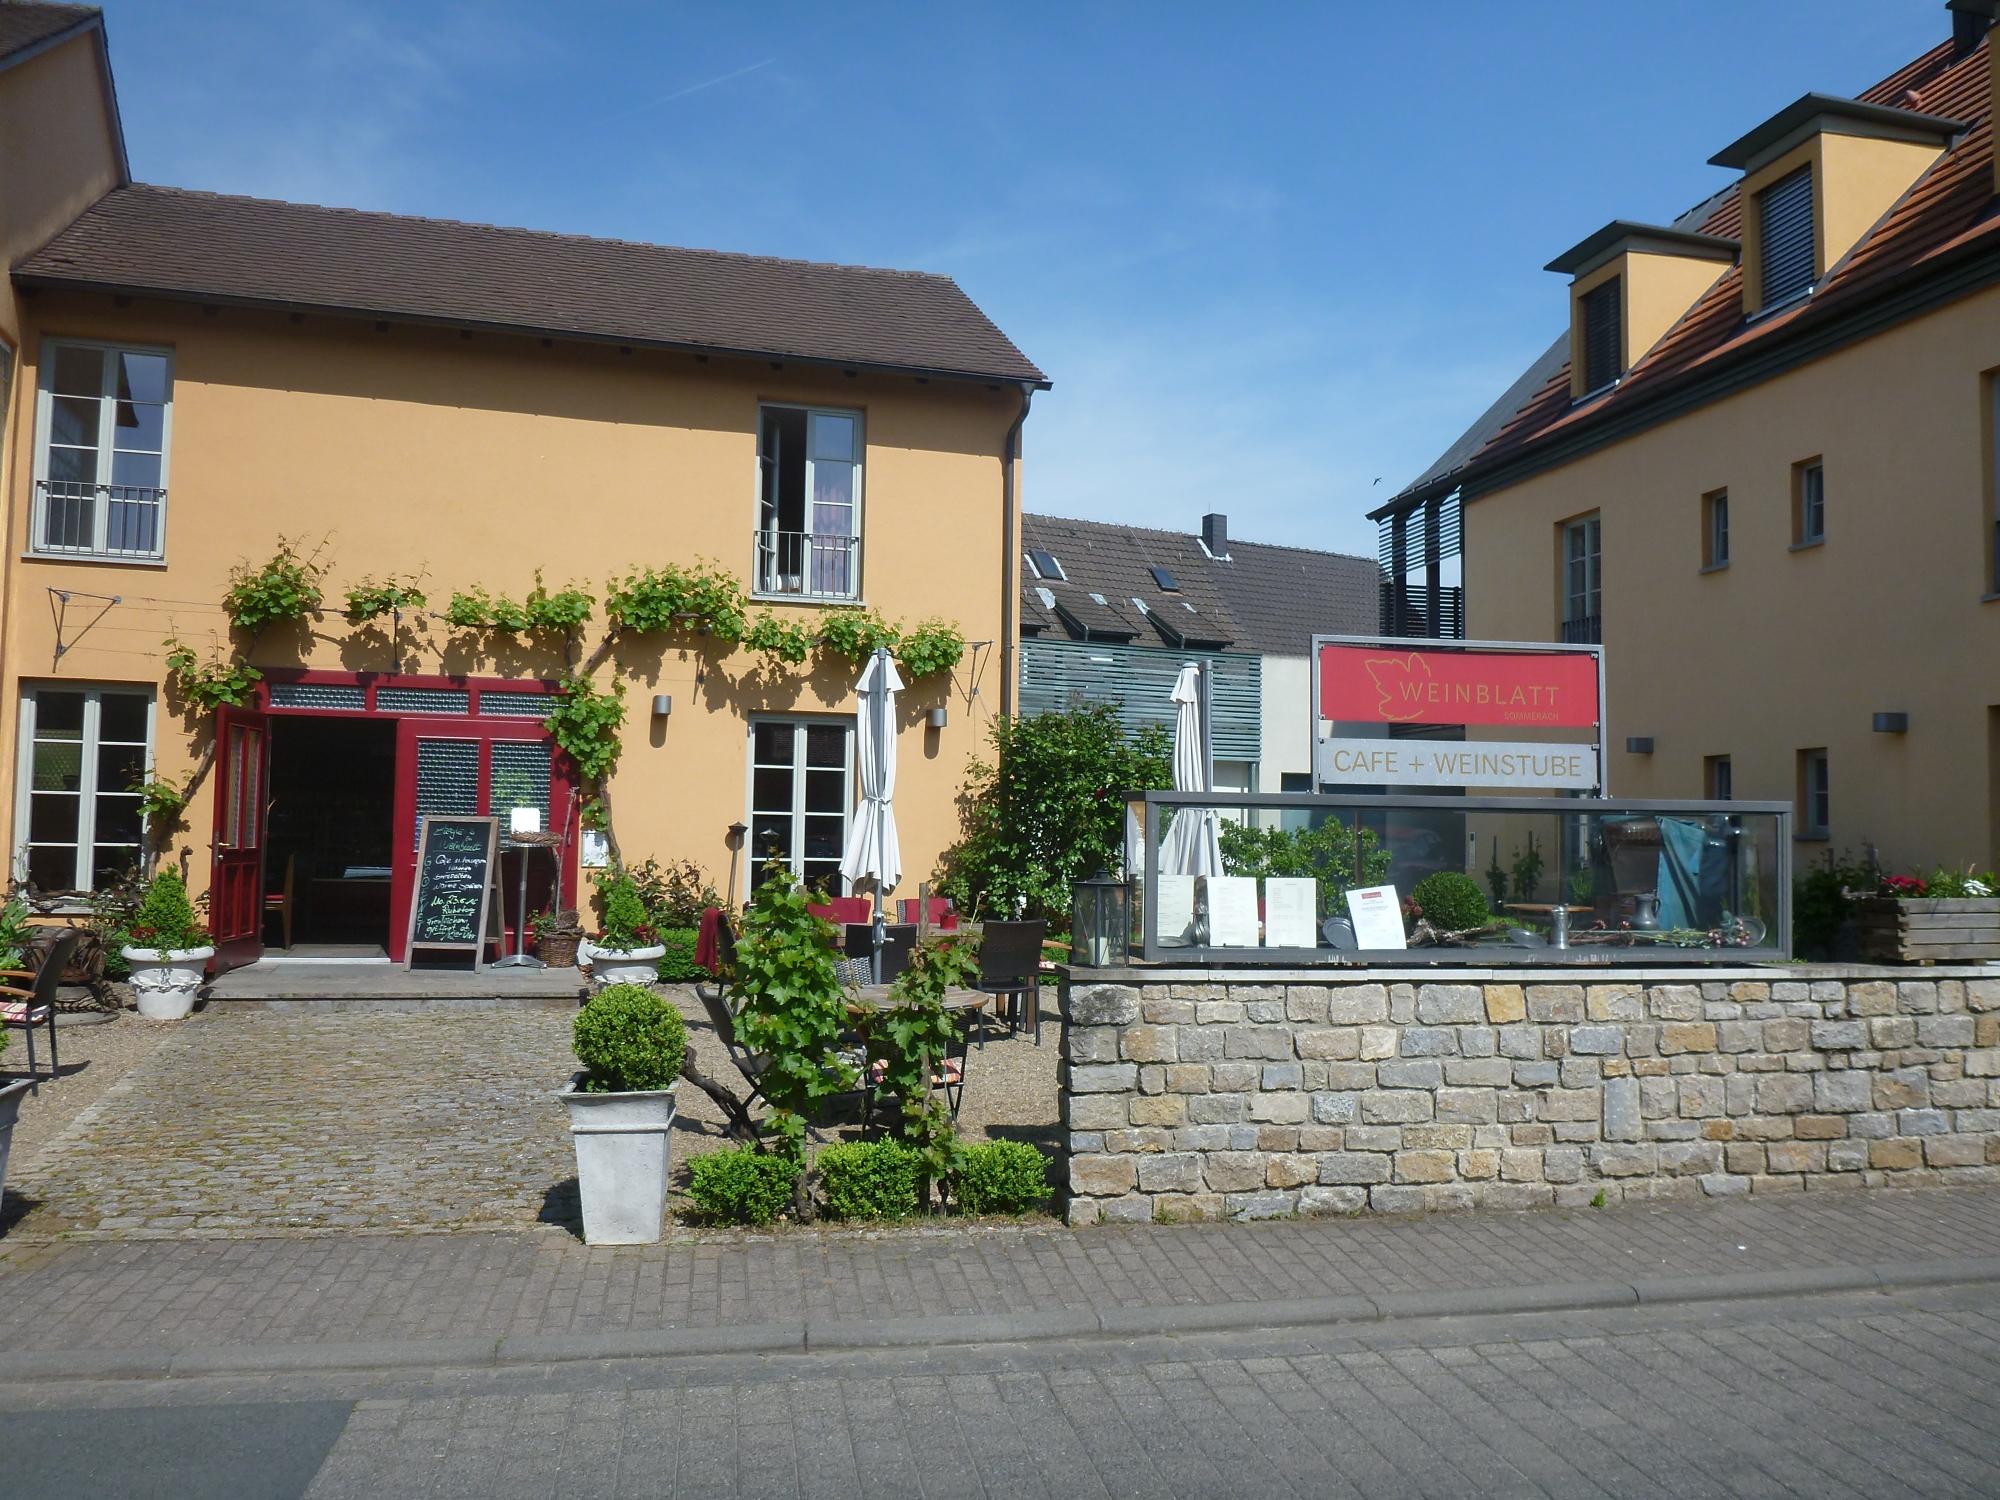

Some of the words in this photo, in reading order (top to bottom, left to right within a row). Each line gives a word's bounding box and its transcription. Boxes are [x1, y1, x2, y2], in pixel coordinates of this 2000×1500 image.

[1399, 681, 1560, 706] WEINBLATT
[1504, 711, 1559, 721] SOMMERACH
[1334, 750, 1399, 773] CAFE
[1408, 755, 1425, 773] +
[1433, 752, 1582, 777] WEINSTUBE
